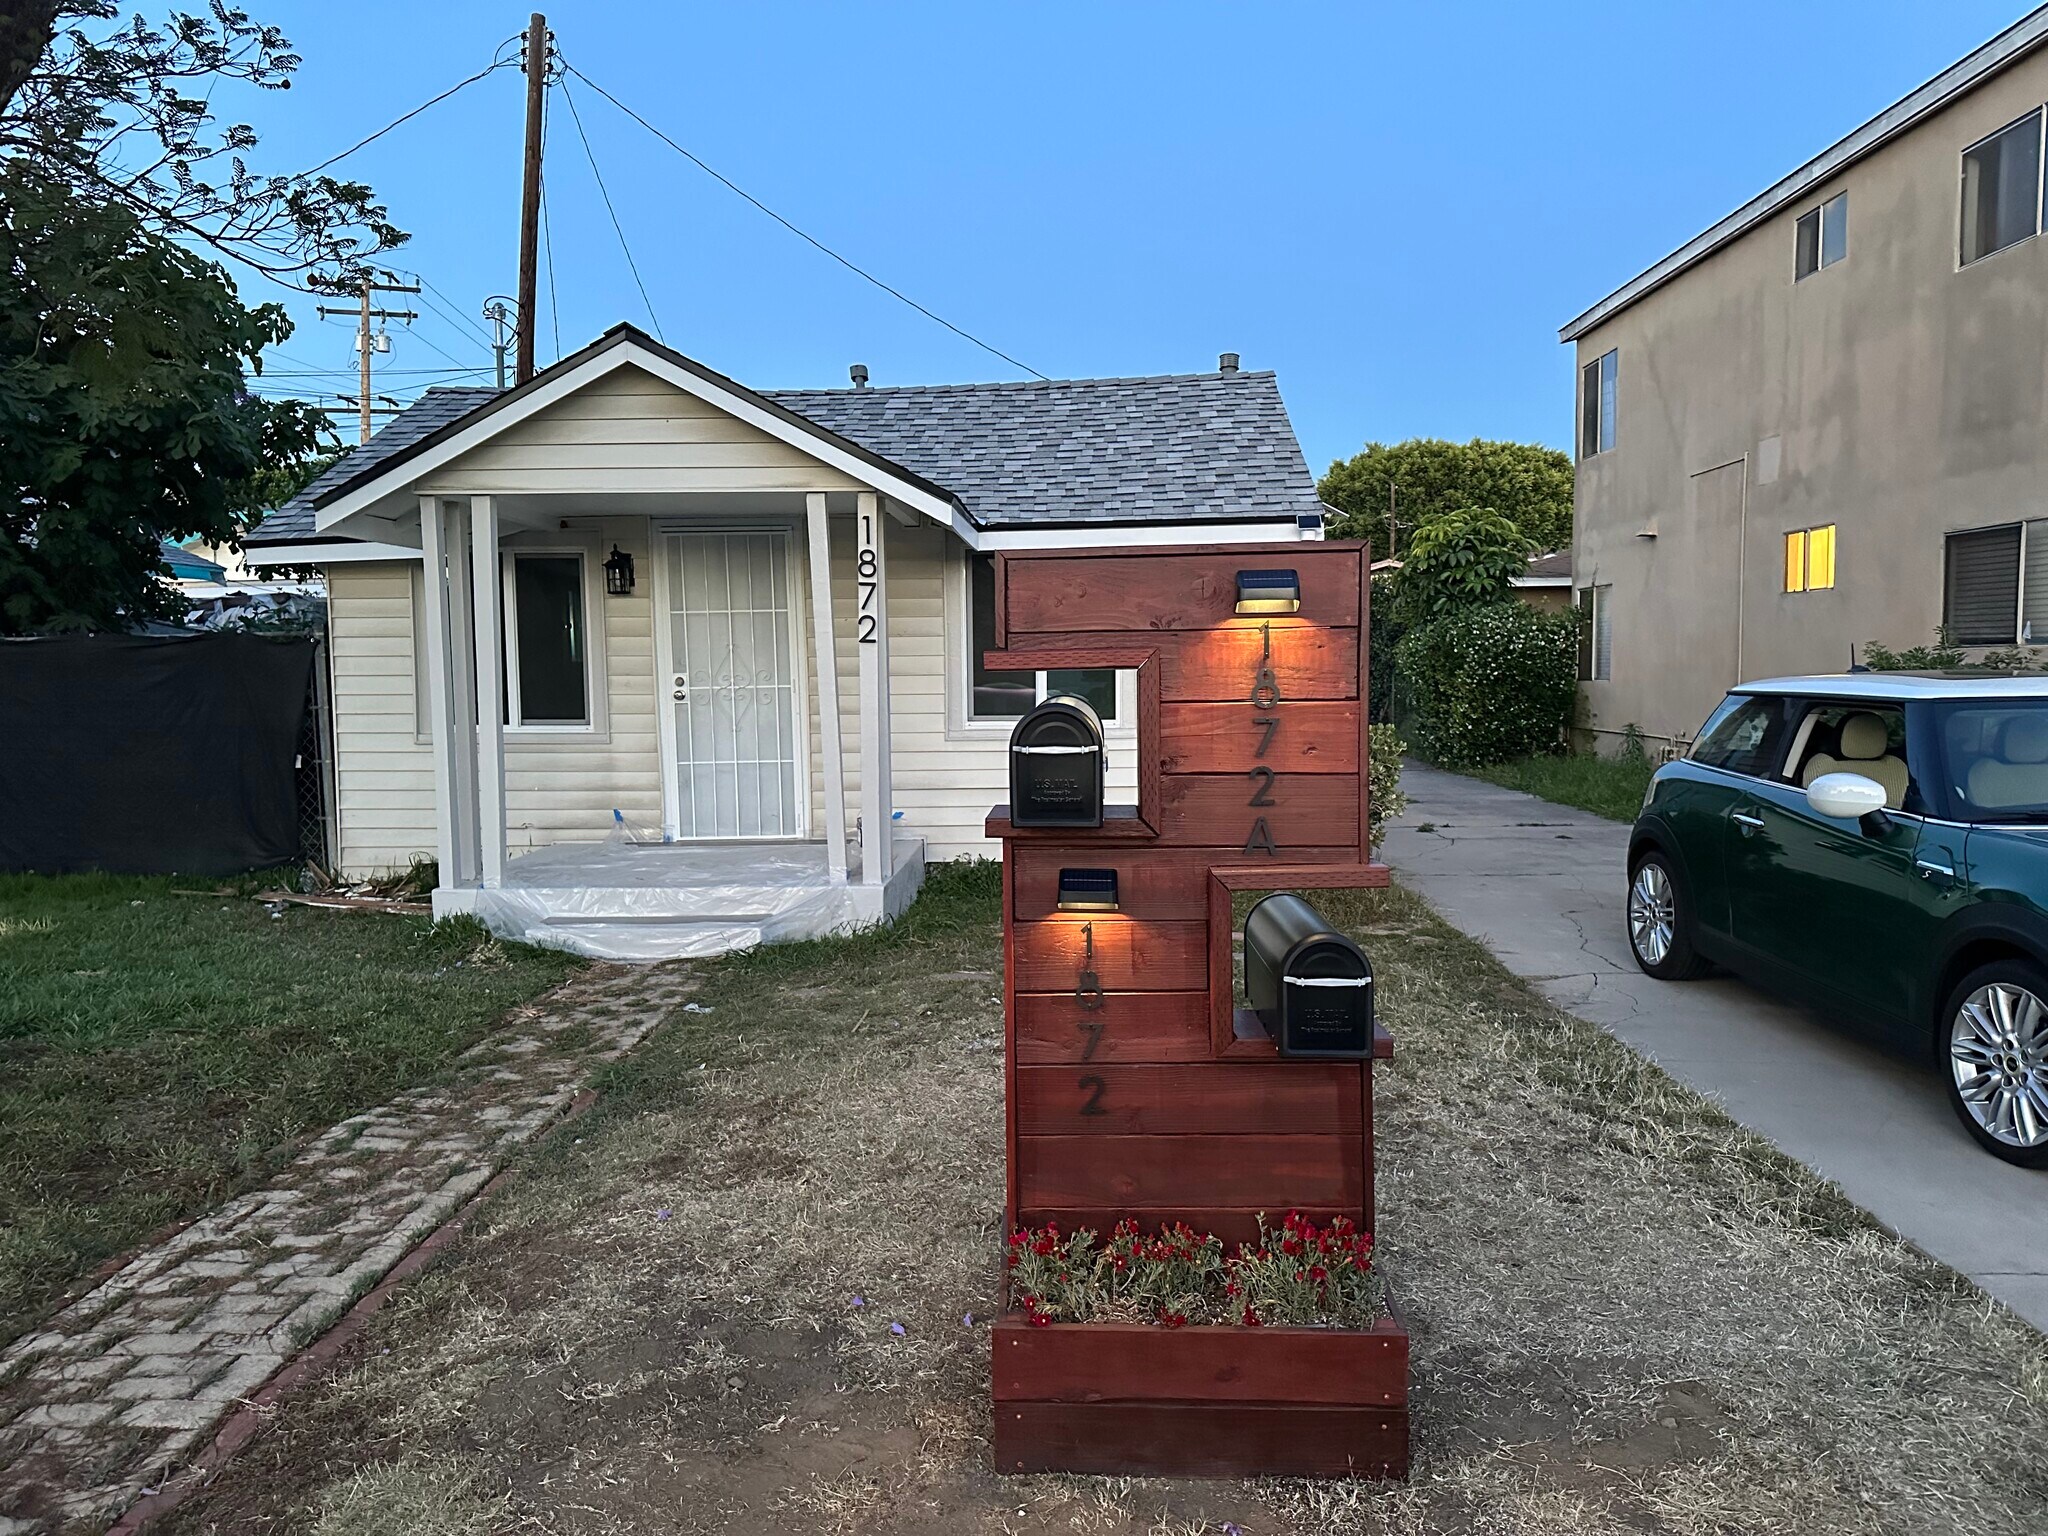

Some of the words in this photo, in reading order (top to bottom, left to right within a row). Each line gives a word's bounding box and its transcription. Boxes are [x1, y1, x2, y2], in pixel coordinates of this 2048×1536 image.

[858, 515, 877, 643] 1872
[1243, 620, 1281, 856] 1872A
[1075, 920, 1107, 1116] 1872
